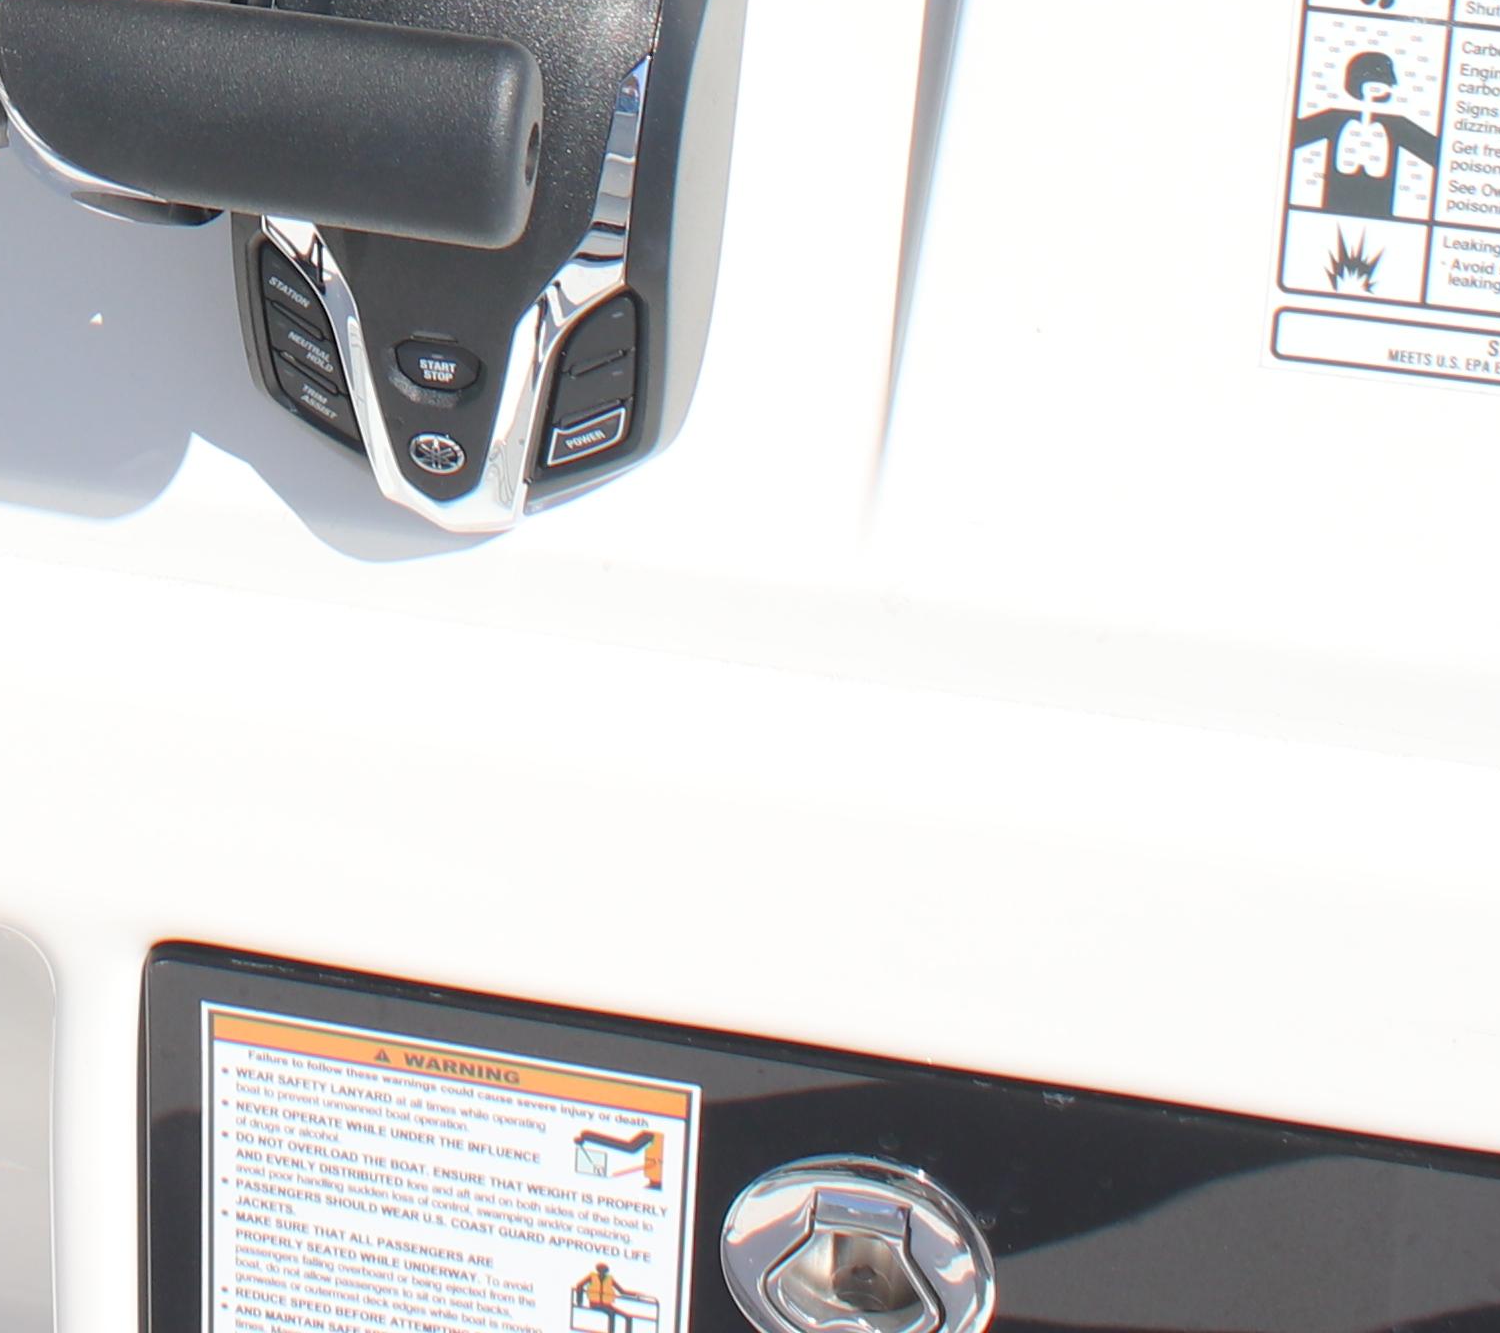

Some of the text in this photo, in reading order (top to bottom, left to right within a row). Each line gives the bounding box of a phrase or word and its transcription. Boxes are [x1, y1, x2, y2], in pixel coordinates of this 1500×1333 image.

[268, 276, 311, 309] STATION
[288, 331, 330, 362] NEUTRAL
[306, 351, 334, 373] HOLD
[419, 359, 457, 373] START
[1387, 349, 1432, 367] MEETS
[1436, 355, 1460, 369] U.S.
[1465, 358, 1491, 373] EPA
[424, 370, 453, 382] STOP
[301, 394, 338, 419] ASSIST
[302, 384, 328, 404] TRIM
[565, 429, 606, 450] POWER
[404, 1052, 521, 1086] WARNING
[236, 1067, 546, 1134] WEAR SAFETY LANYARD at all times while operating
[236, 1100, 540, 1165] NEVER OPERATE WHILE UNDER THE INFLUENCE
[236, 1131, 254, 1145] DO
[258, 1135, 283, 1150] NOT
[287, 1140, 358, 1164] OVERLOAD
[362, 1154, 386, 1169] THE
[433, 1166, 485, 1186] ENSURE
[490, 1177, 522, 1192] THAT
[527, 1183, 577, 1202] WEIGHT
[581, 1193, 593, 1206] IS
[597, 1195, 666, 1218] PROPERLY
